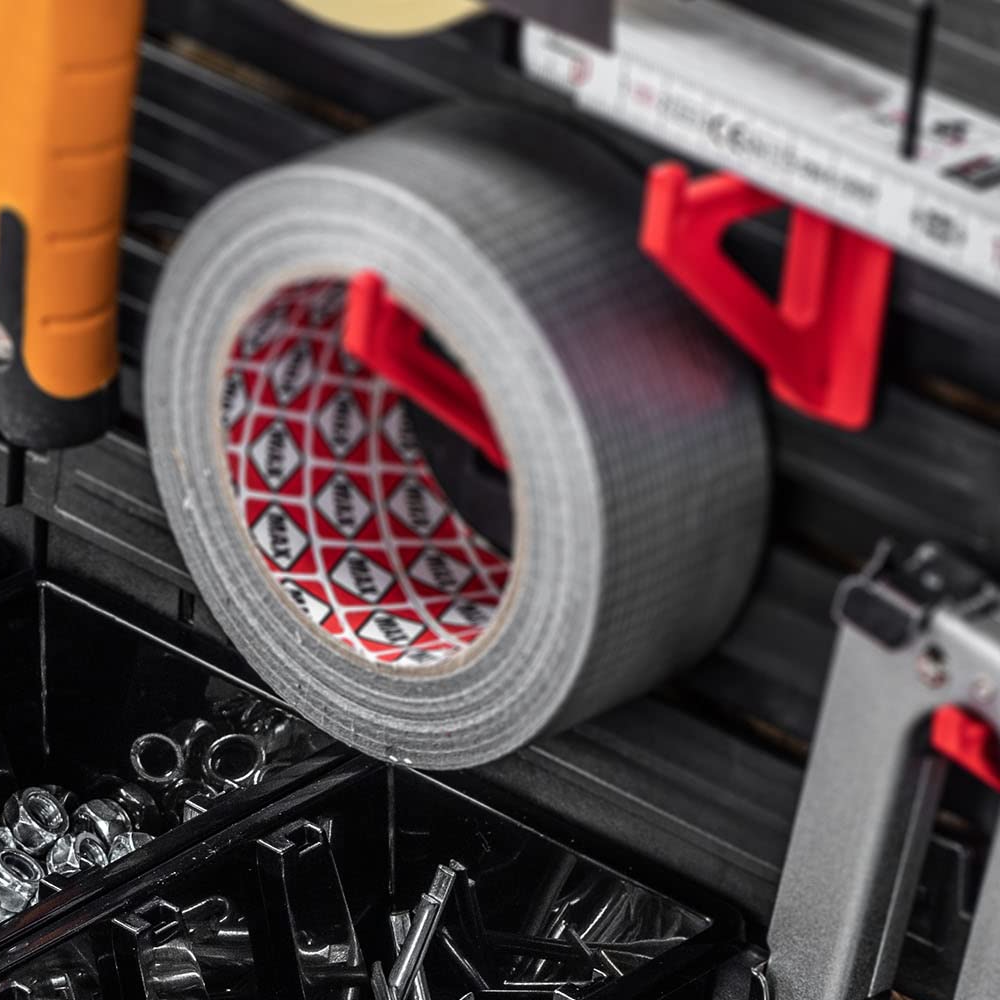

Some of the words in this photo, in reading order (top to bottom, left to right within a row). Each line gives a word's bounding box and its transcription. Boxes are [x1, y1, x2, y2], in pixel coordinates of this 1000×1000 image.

[332, 483, 354, 525] MAX
[267, 512, 291, 559] MAX
[348, 556, 378, 594] MAX
[374, 615, 408, 644] MAX
